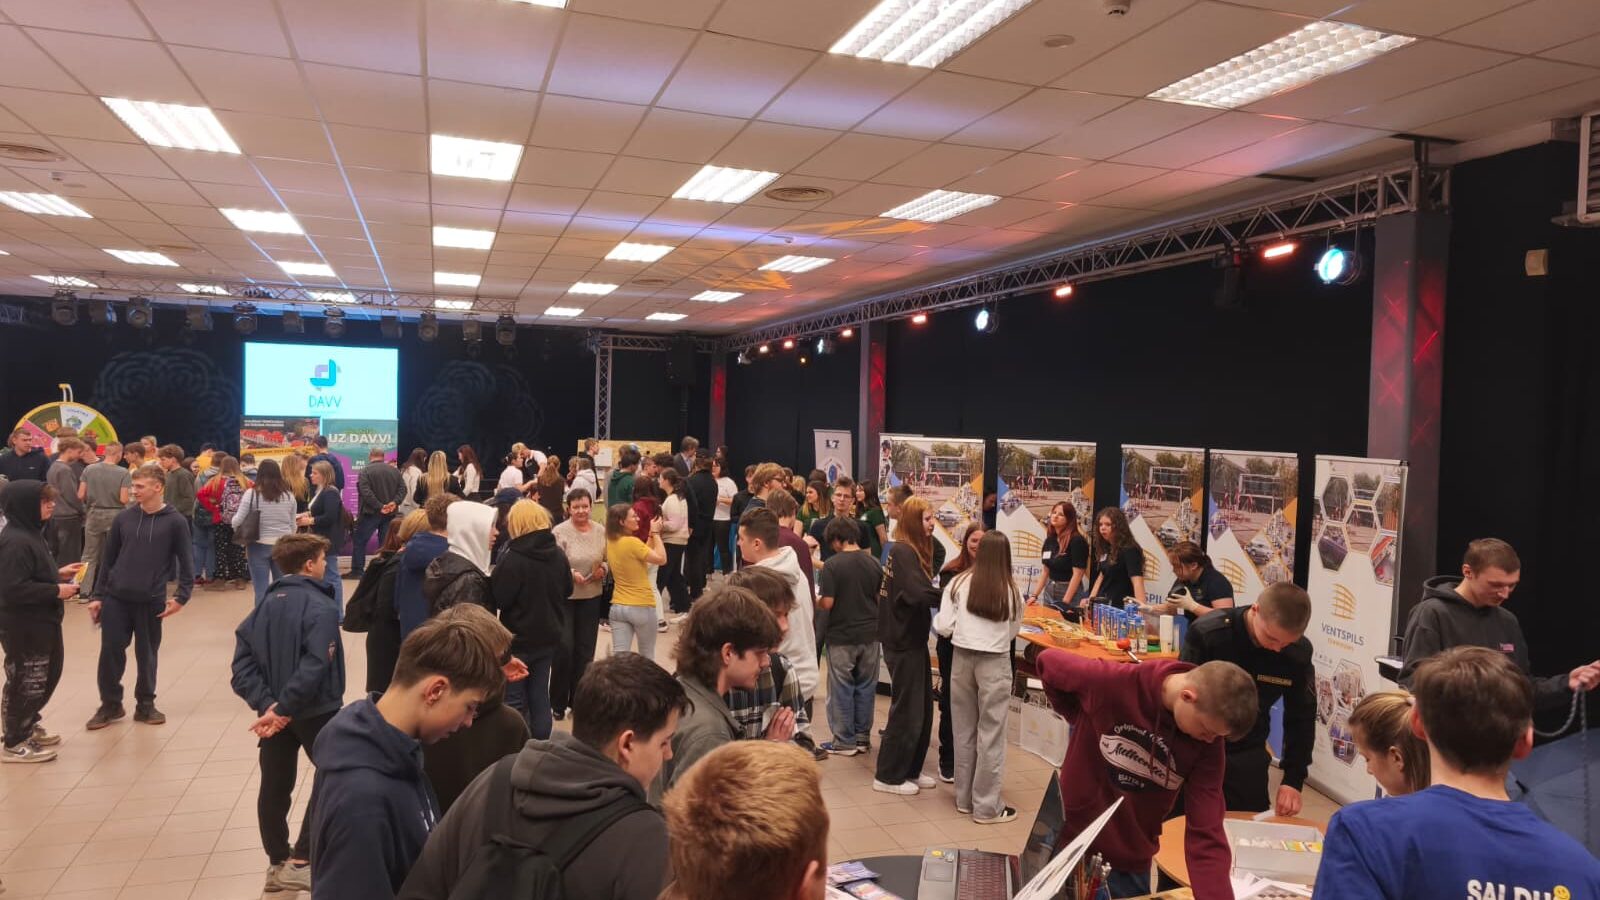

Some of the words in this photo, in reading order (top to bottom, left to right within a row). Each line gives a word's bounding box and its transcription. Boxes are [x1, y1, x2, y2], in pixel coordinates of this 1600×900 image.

[309, 394, 342, 408] DAVV
[328, 433, 347, 443] UZ
[350, 433, 391, 443] DAVV!
[1321, 621, 1364, 646] VENTSPILS
